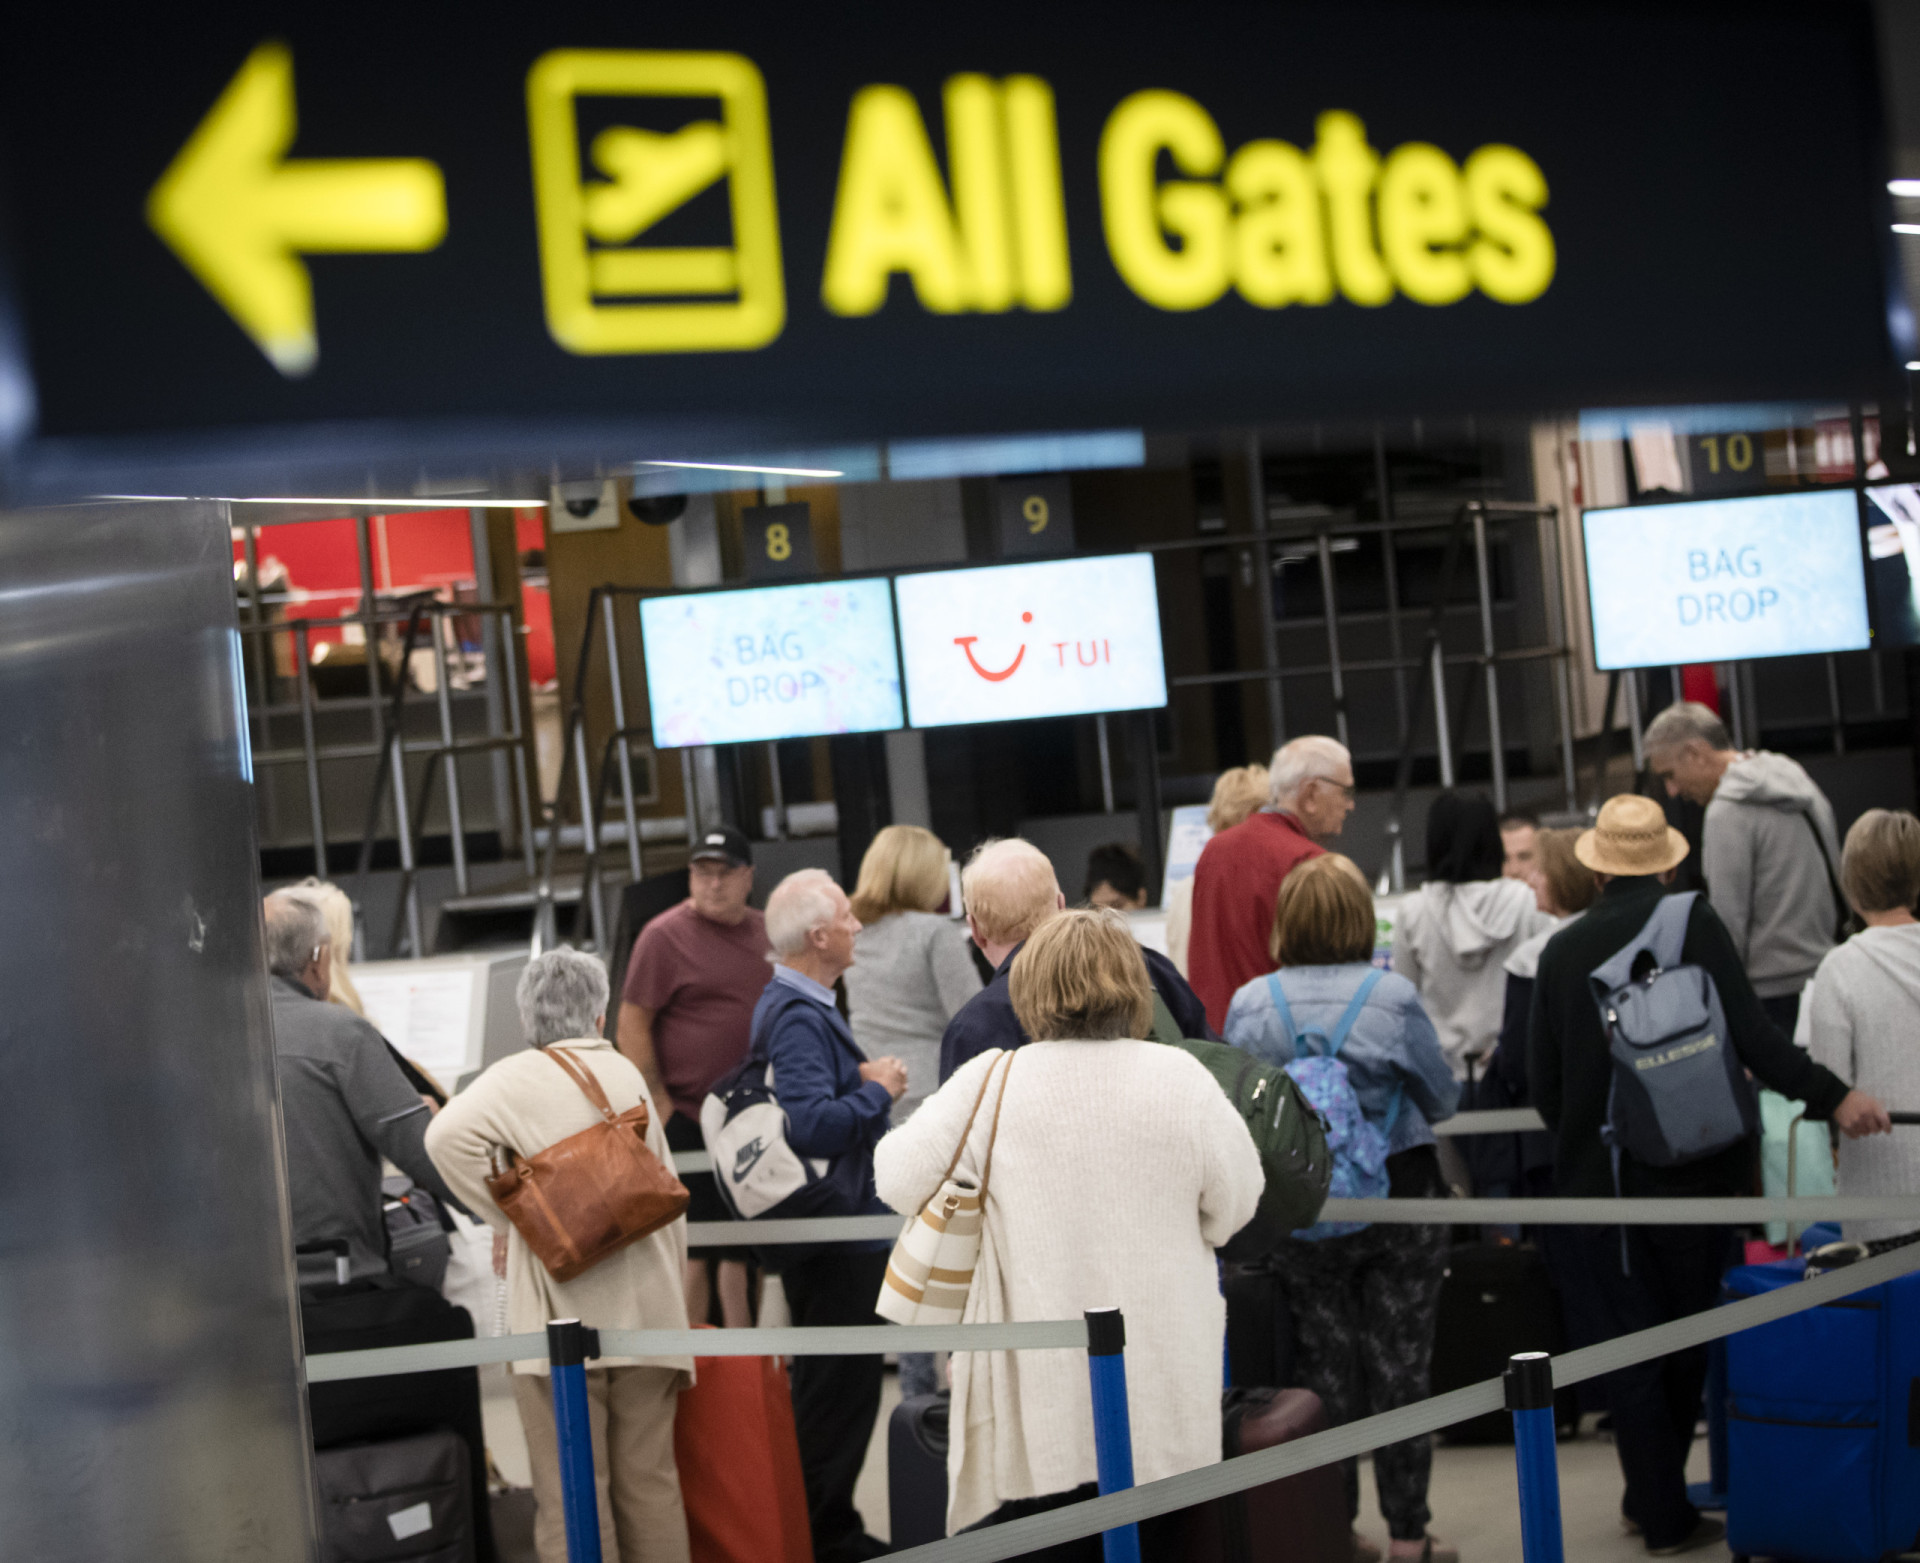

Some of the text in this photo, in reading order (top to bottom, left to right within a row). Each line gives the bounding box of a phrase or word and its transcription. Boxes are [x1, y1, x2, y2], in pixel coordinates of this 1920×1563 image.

[821, 73, 1556, 316] All Gates
[1702, 434, 1753, 474] 10
[1023, 496, 1049, 534] 9
[766, 523, 791, 561] 8
[1688, 545, 1762, 582] BAG
[1677, 586, 1779, 626] DROP
[735, 630, 804, 665] BAG
[1052, 639, 1110, 667] TUI
[726, 671, 825, 707] DROP
